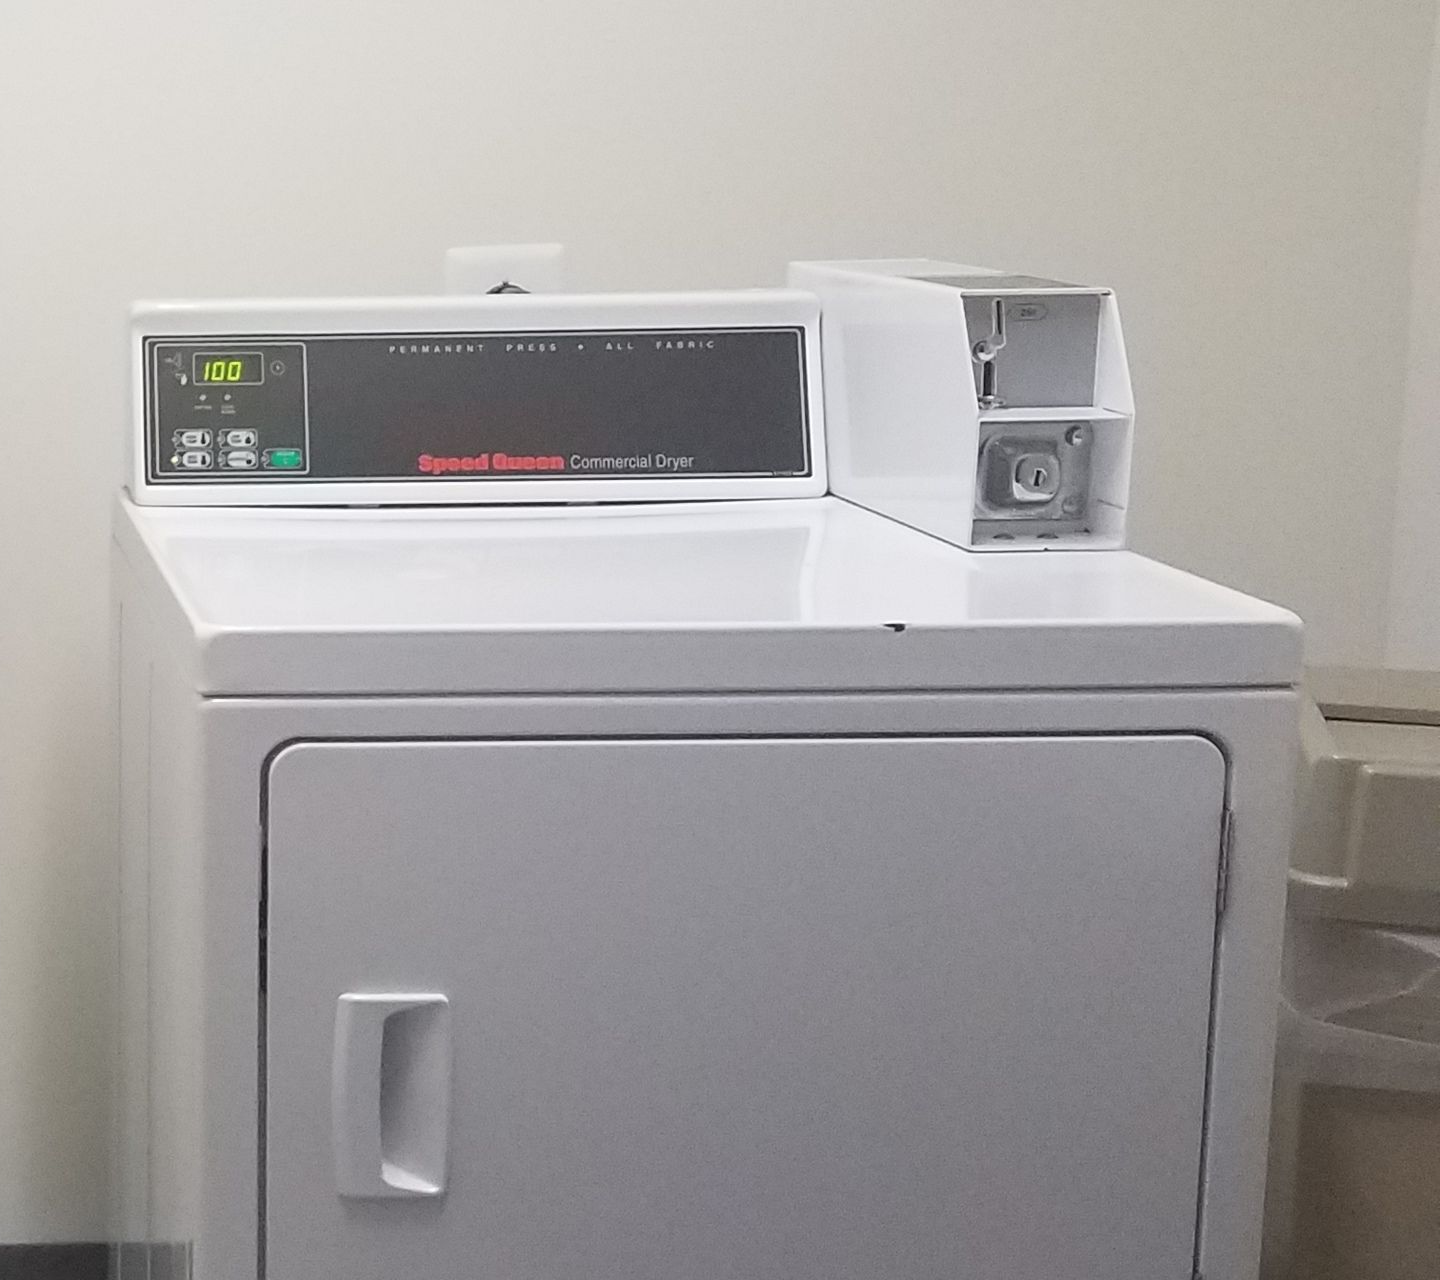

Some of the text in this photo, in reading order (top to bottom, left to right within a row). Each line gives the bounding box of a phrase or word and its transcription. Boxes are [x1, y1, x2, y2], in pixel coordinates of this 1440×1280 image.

[388, 339, 715, 354] PERMANENT PRESS ALL FABRIC
[203, 360, 242, 382] 100
[418, 452, 695, 475] Speed Queen Commercial Dryer
